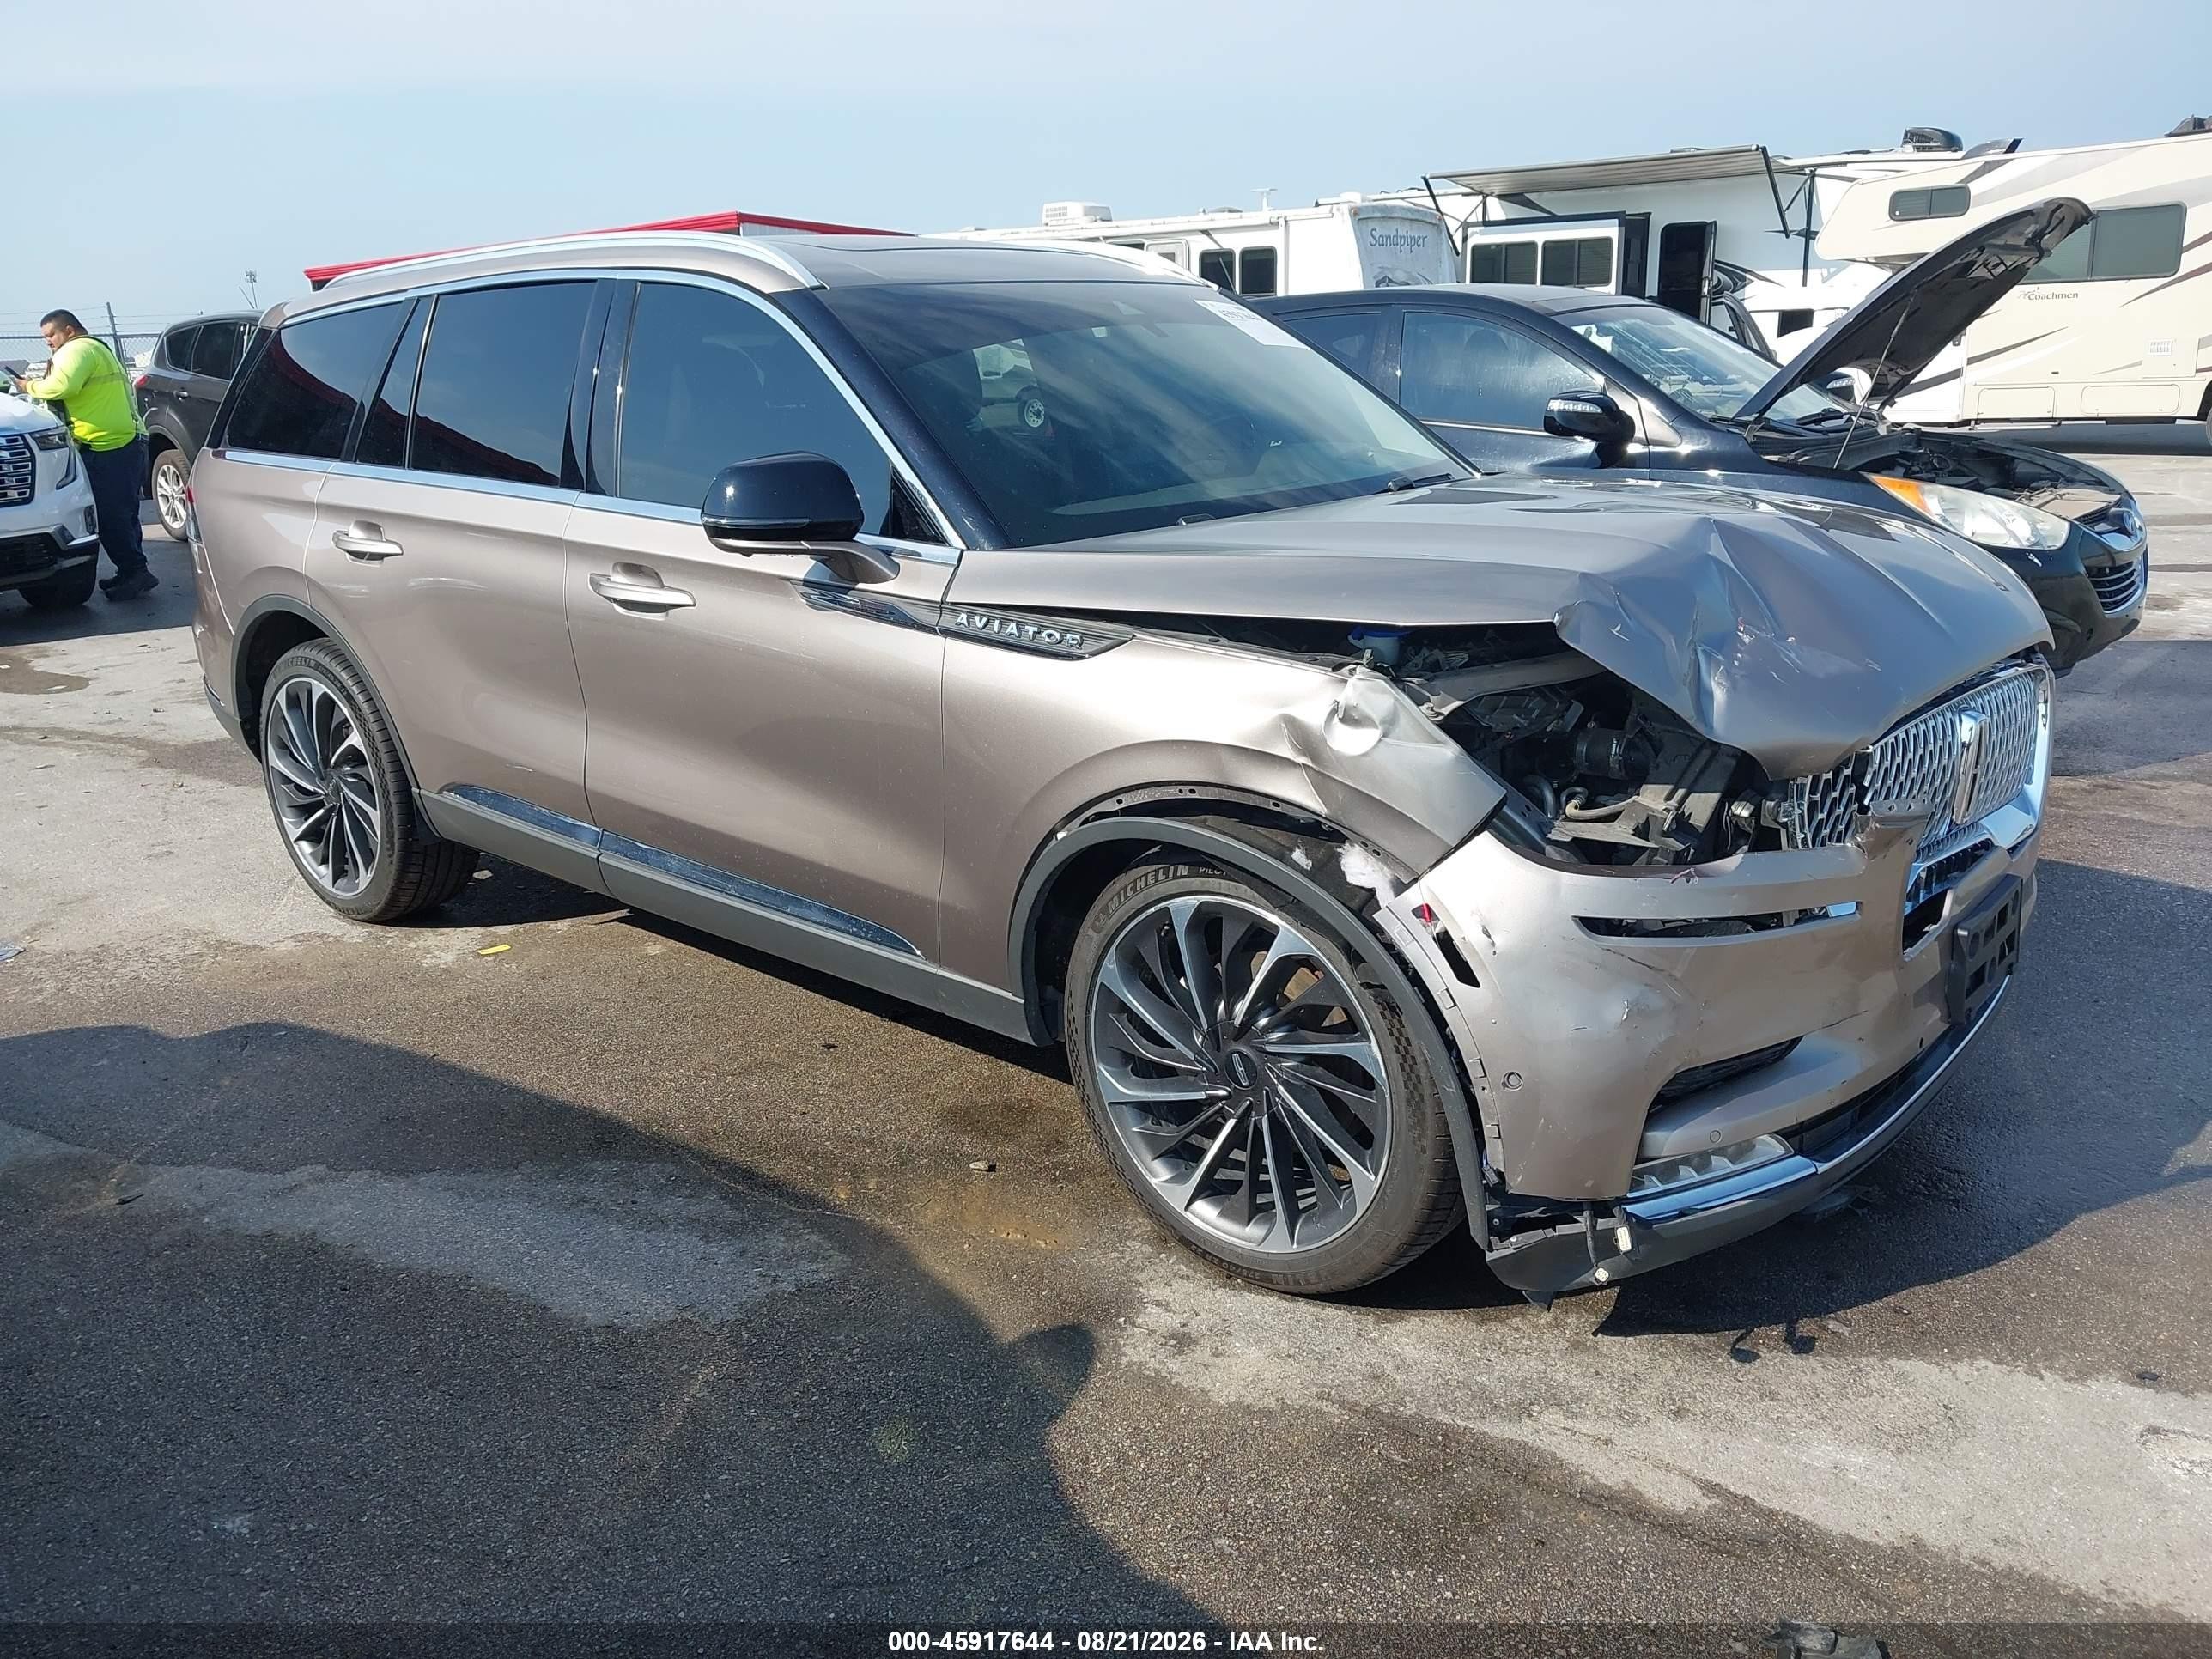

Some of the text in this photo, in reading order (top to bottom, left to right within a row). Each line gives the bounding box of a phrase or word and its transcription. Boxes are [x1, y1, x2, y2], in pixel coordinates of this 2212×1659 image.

[1369, 228, 1428, 254] Sandpiper
[2027, 292, 2079, 301] Coachmen
[954, 611, 1085, 651] AVIATOR
[1108, 864, 1190, 915] MICHELIN
